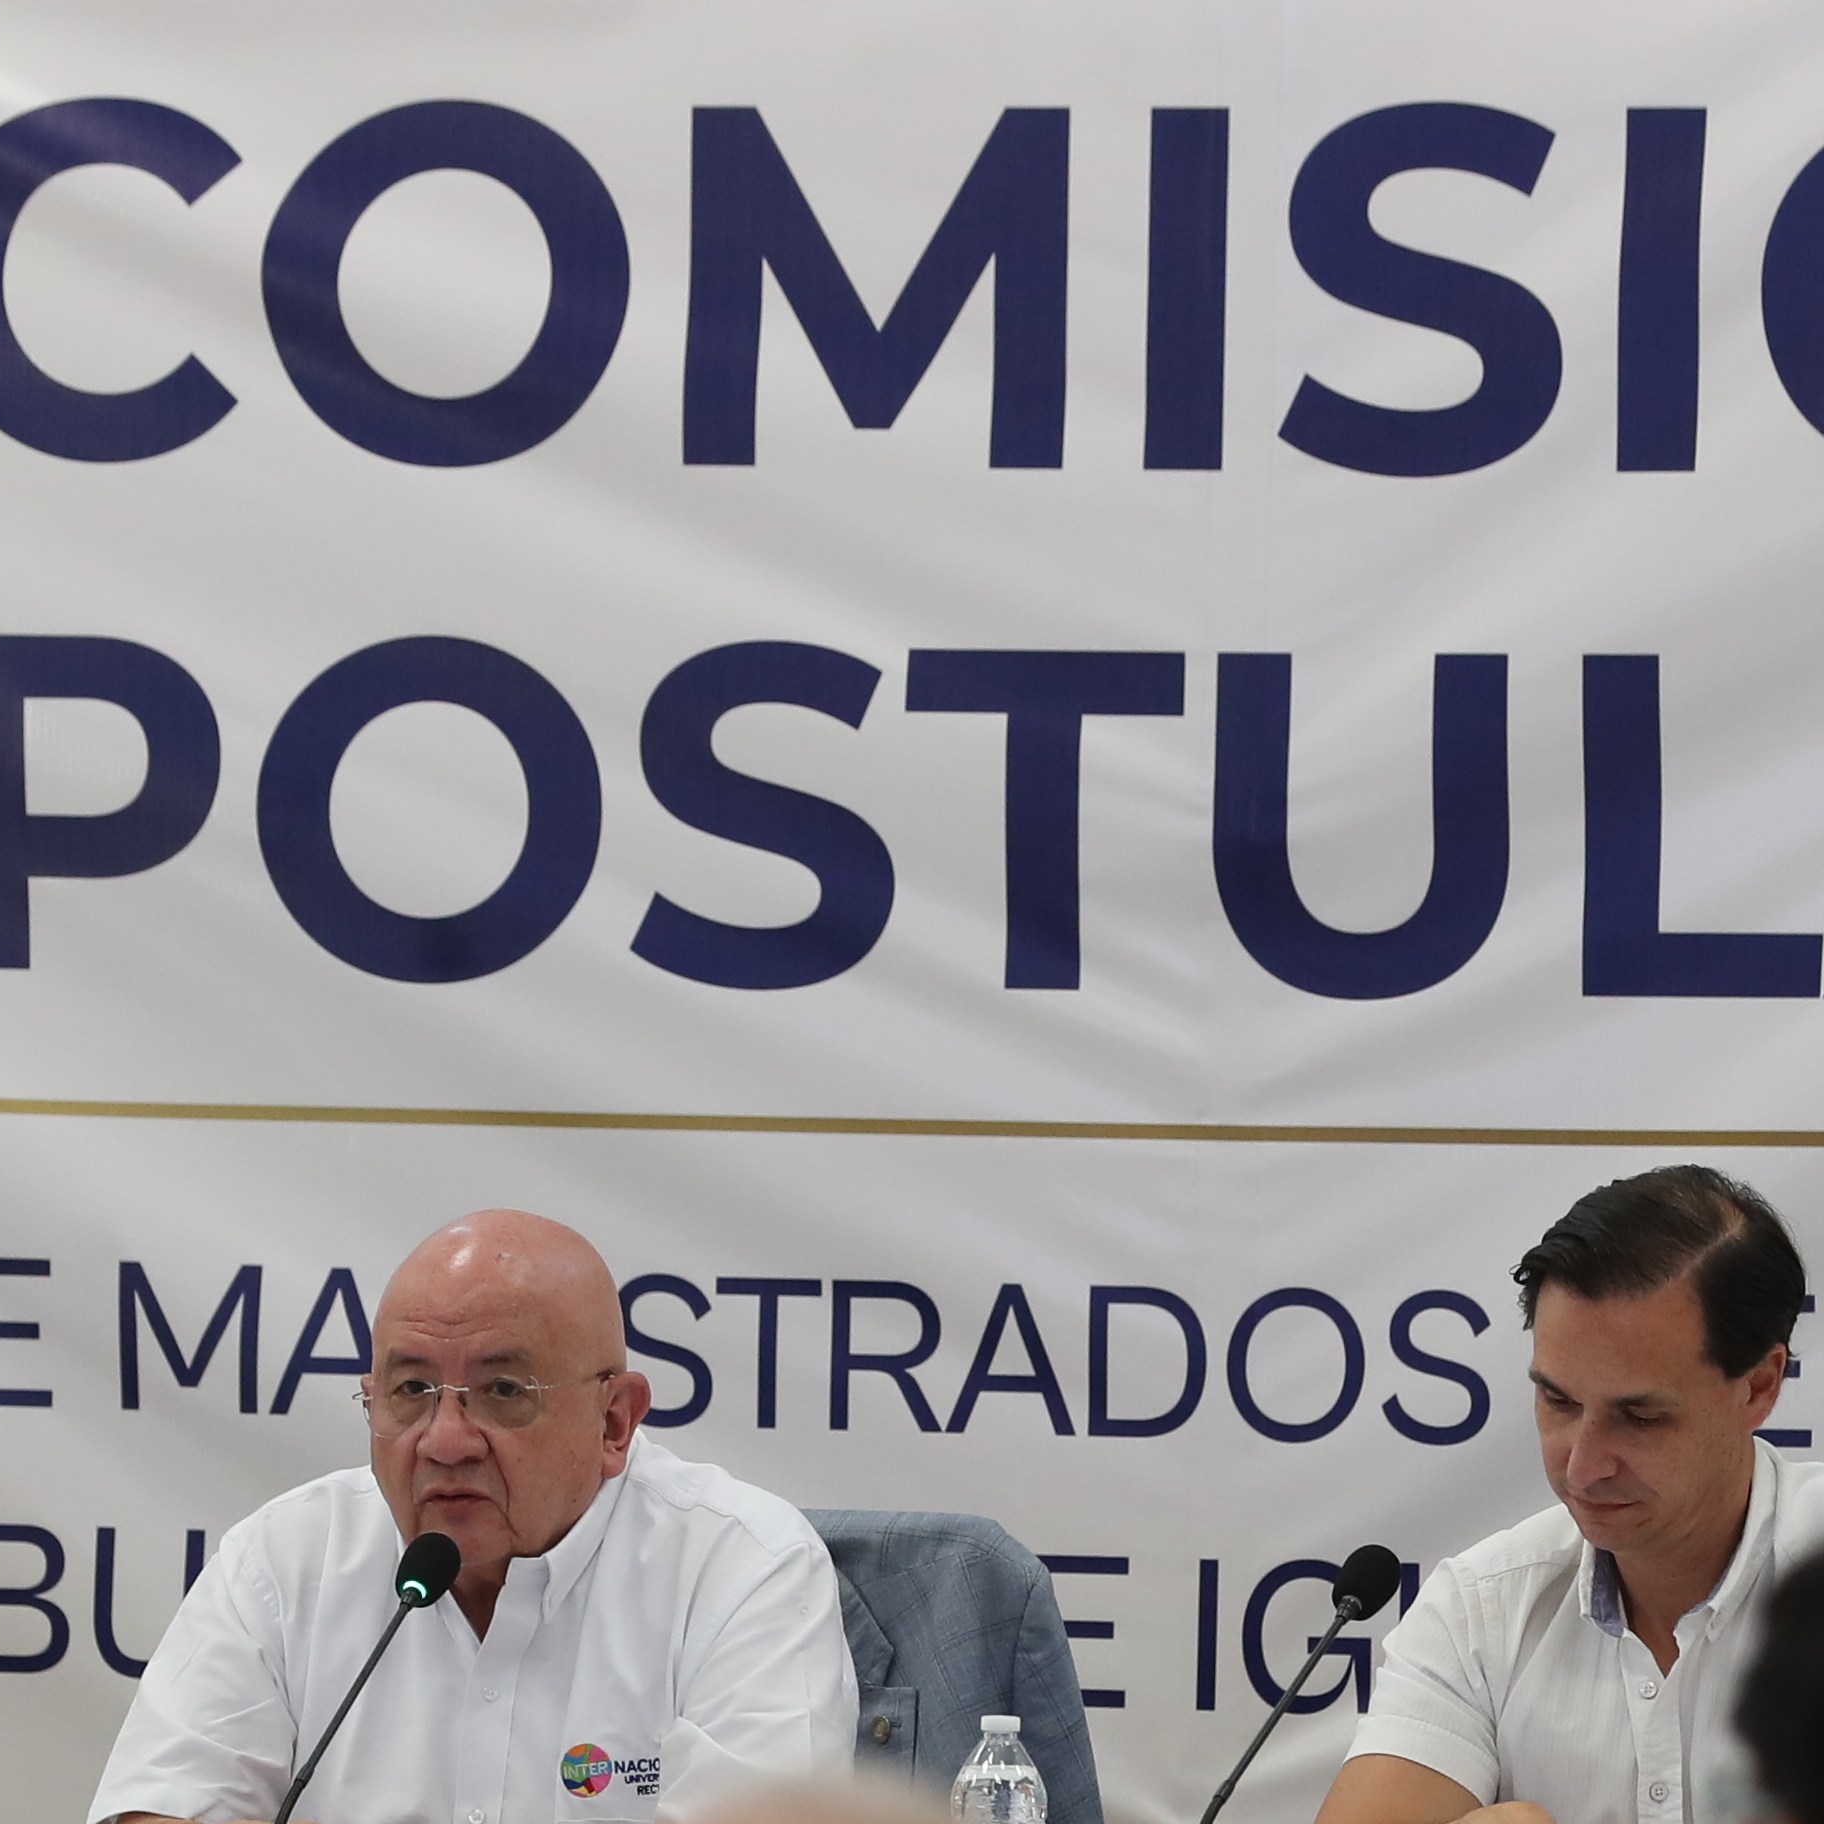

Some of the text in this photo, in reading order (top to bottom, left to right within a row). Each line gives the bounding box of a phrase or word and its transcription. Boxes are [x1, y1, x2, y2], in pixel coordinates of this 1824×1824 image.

[117, 1260, 1491, 1447] MASTRADOS
[563, 1757, 660, 1778] INTER NACIO
